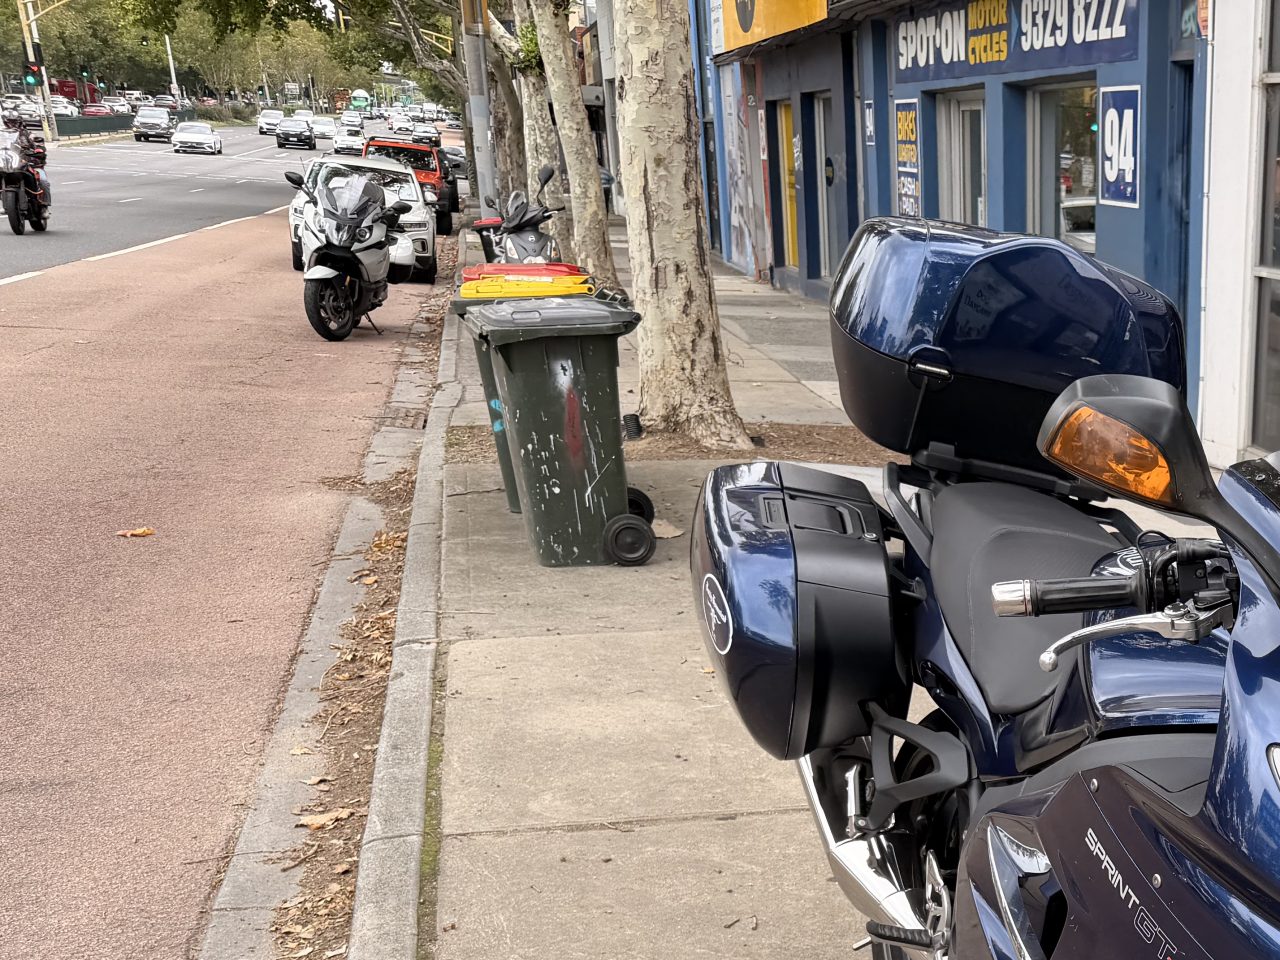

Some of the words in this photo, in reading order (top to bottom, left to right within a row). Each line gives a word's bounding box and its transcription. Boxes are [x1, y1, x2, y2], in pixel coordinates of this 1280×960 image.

[968, 0, 1008, 30] MOTOR
[1021, 0, 1069, 51] 9329
[968, 31, 1008, 65] CYCLES
[1104, 108, 1135, 182] 94
[1085, 828, 1140, 909] SPRINT
[1134, 906, 1178, 960] GT
